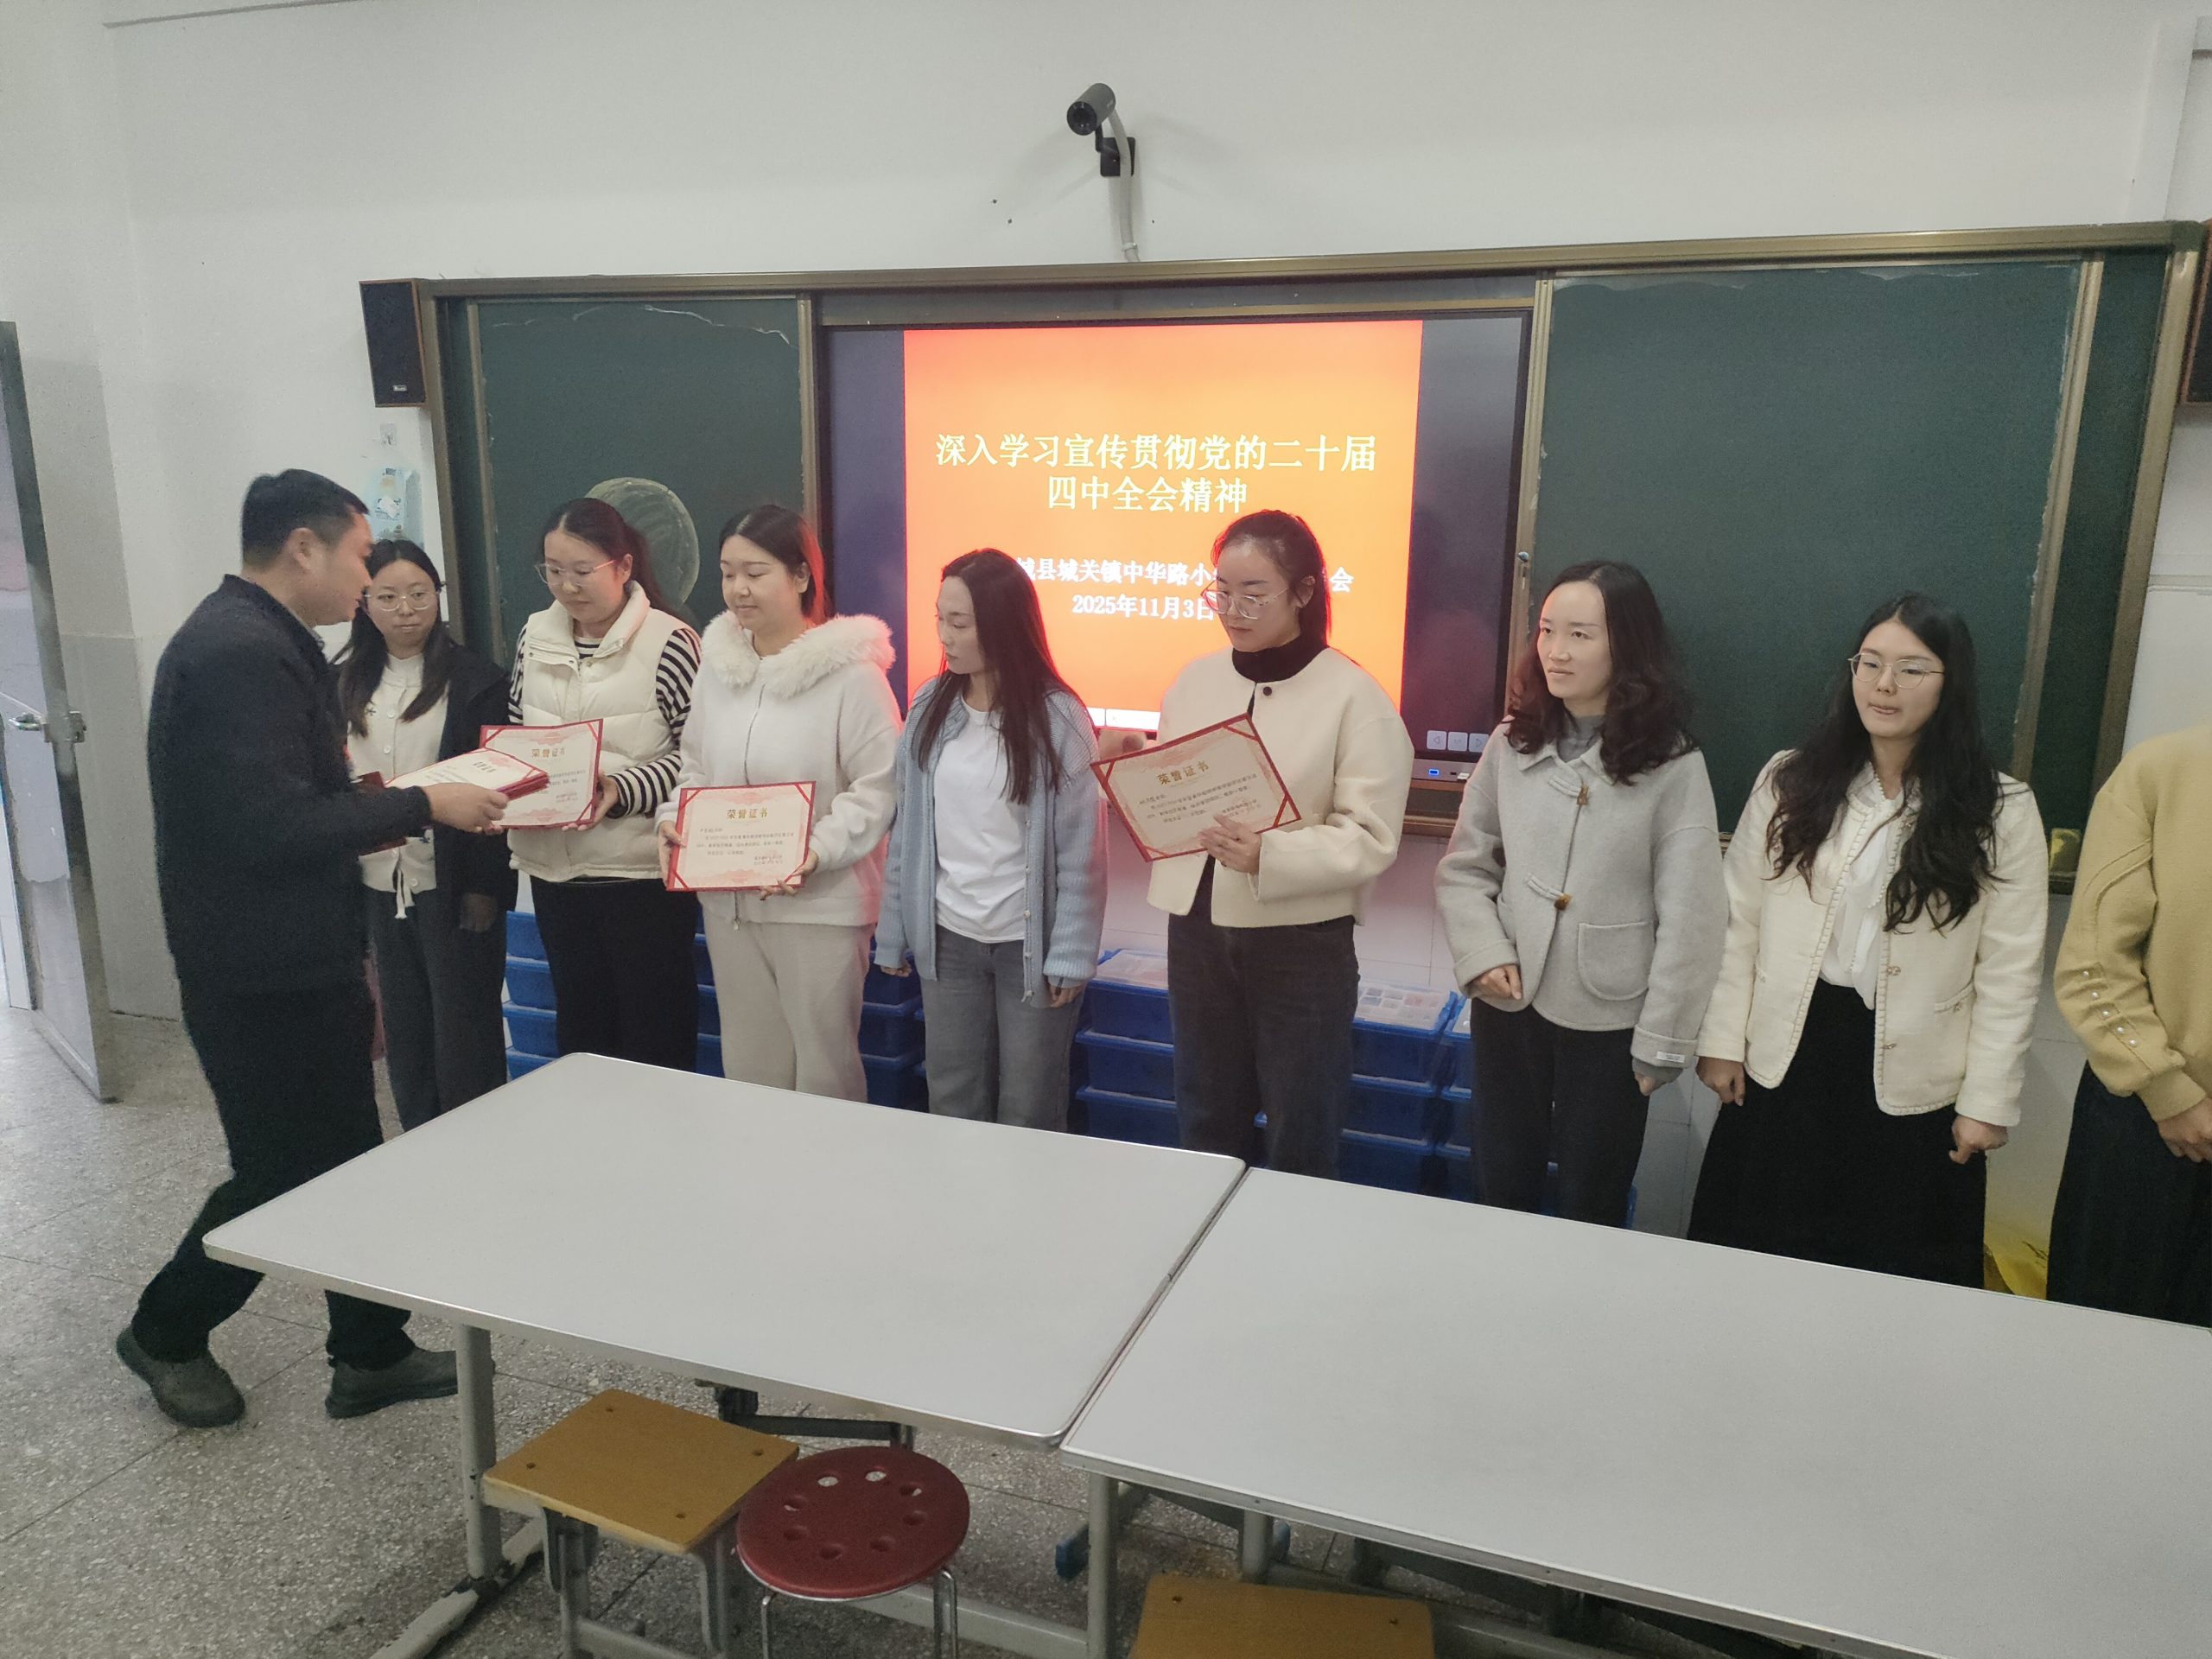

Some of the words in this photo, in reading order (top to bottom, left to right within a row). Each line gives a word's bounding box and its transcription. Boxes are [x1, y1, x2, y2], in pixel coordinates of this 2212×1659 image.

[936, 433, 1376, 472] 深入学习宣传贯彻党的二十届
[1048, 475, 1247, 513] 四中全会精神
[1015, 557, 1217, 586] 城县城关镇中华路小
[1071, 594, 1214, 620] 2025年11月3日
[1156, 760, 1209, 785] 荣誉证书
[726, 807, 768, 820] 荣誉证书
